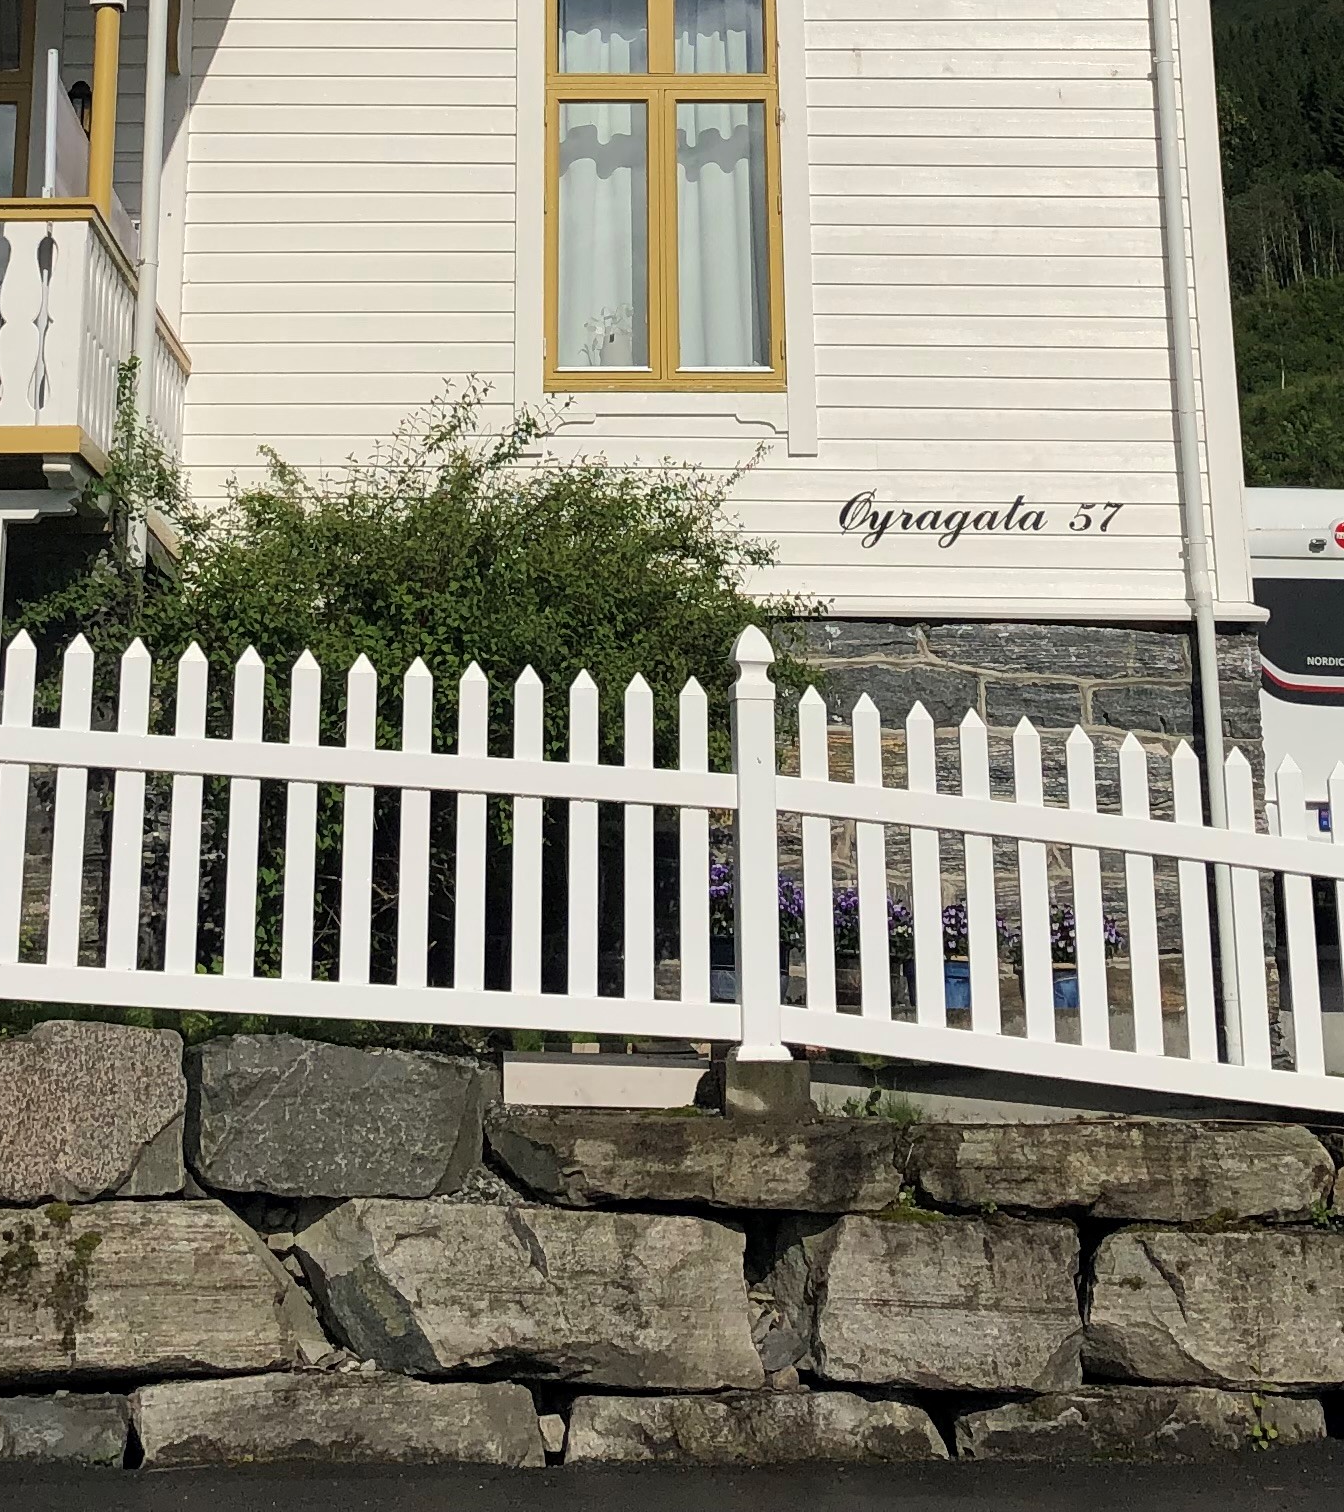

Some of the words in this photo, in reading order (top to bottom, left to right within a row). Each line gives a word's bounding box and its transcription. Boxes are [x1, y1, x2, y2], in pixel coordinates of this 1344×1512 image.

[839, 488, 1048, 548] Øyragata
[1069, 502, 1124, 532] 57
[1306, 656, 1344, 667] NORDIC
